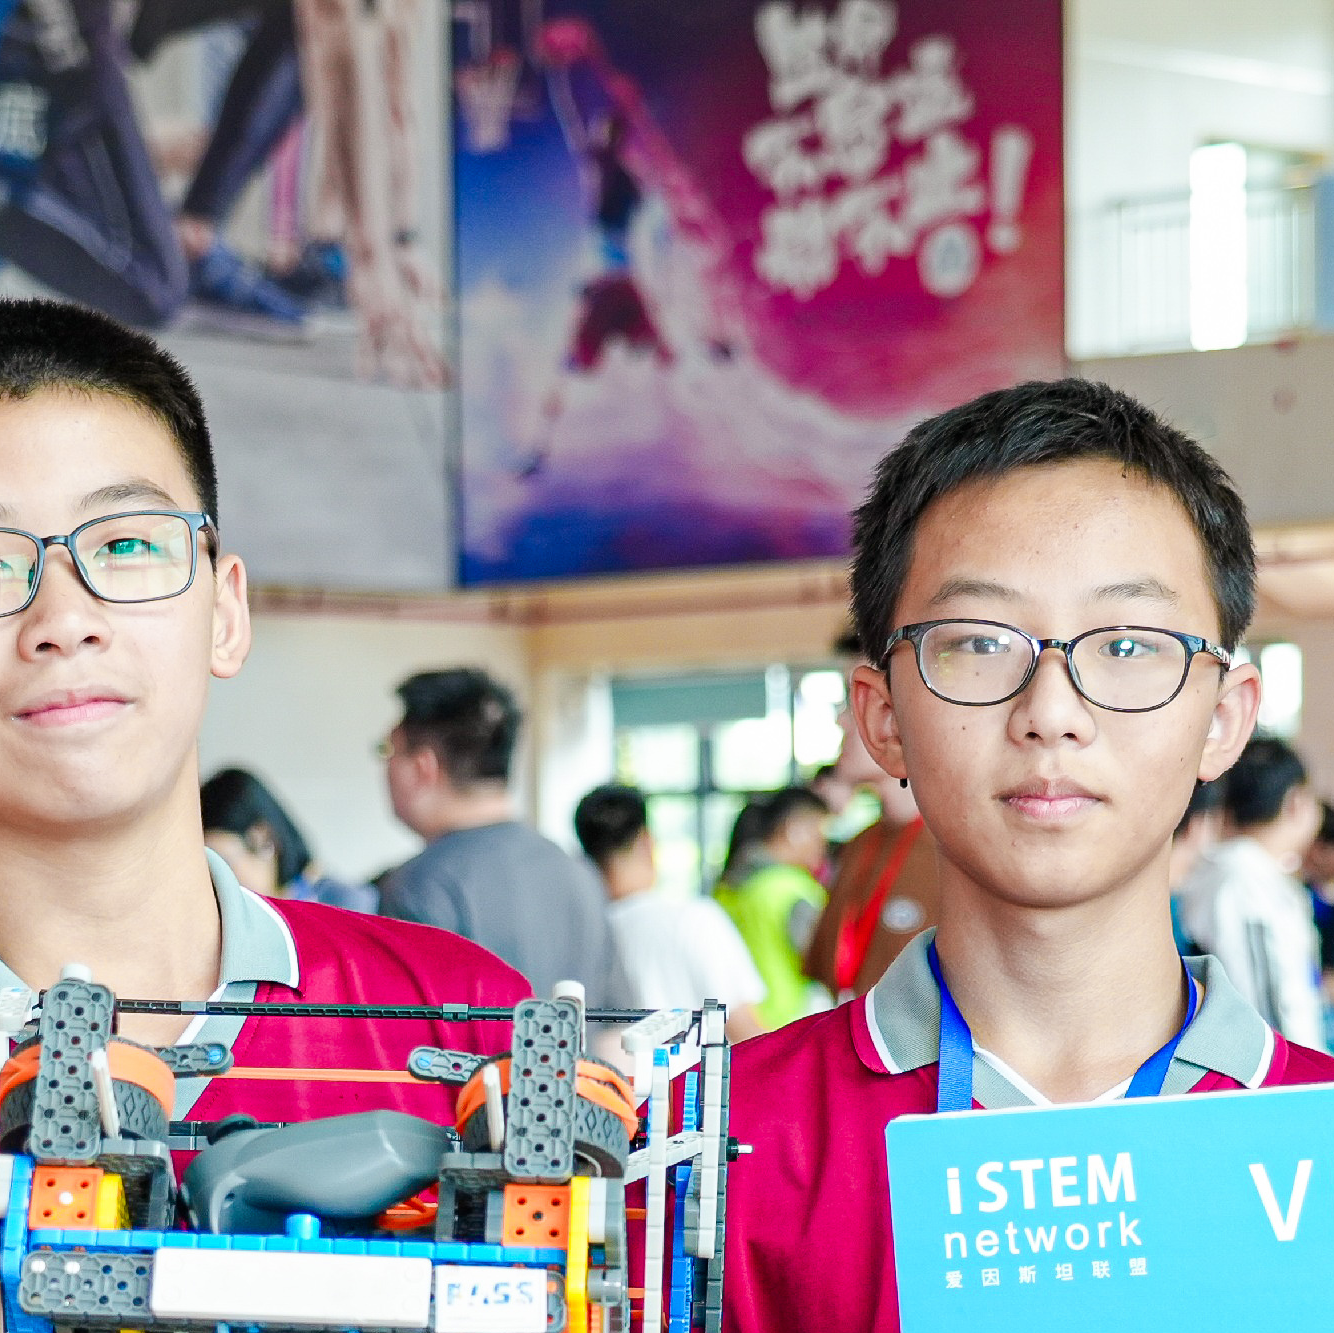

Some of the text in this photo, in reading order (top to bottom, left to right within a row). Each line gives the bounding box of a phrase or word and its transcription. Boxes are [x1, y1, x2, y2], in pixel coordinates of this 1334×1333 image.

[943, 1211, 1143, 1260] network
[945, 1257, 1148, 1289] 爱因斯坦联盟
